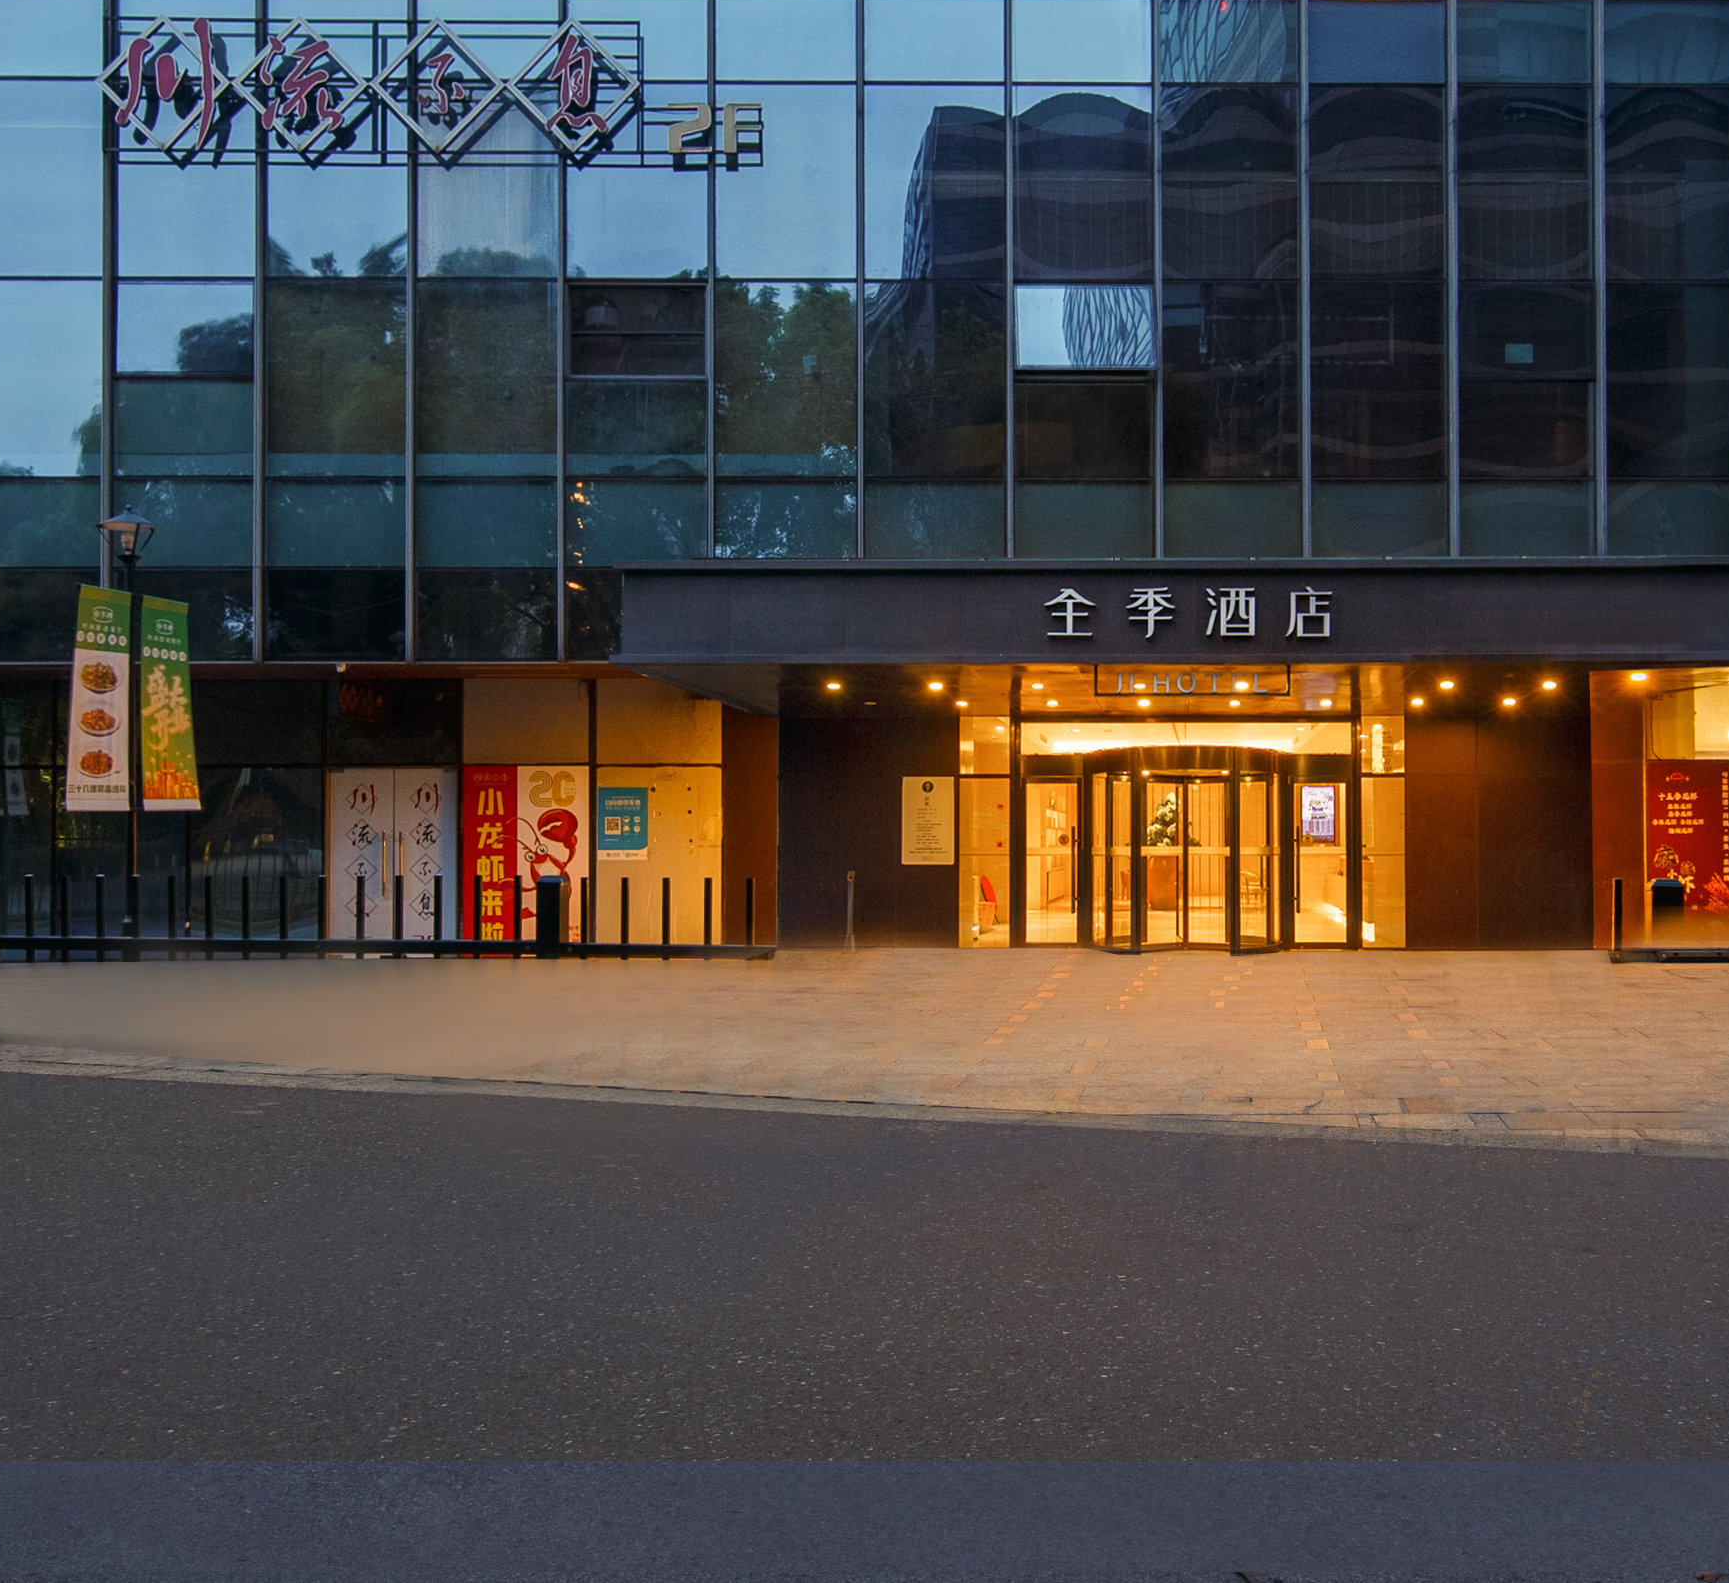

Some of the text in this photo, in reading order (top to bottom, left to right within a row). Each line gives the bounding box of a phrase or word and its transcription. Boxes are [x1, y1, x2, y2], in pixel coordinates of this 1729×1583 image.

[114, 18, 763, 155] 川流不息 2F
[1044, 586, 1333, 639] 全季酒店
[1116, 673, 1134, 694] JI
